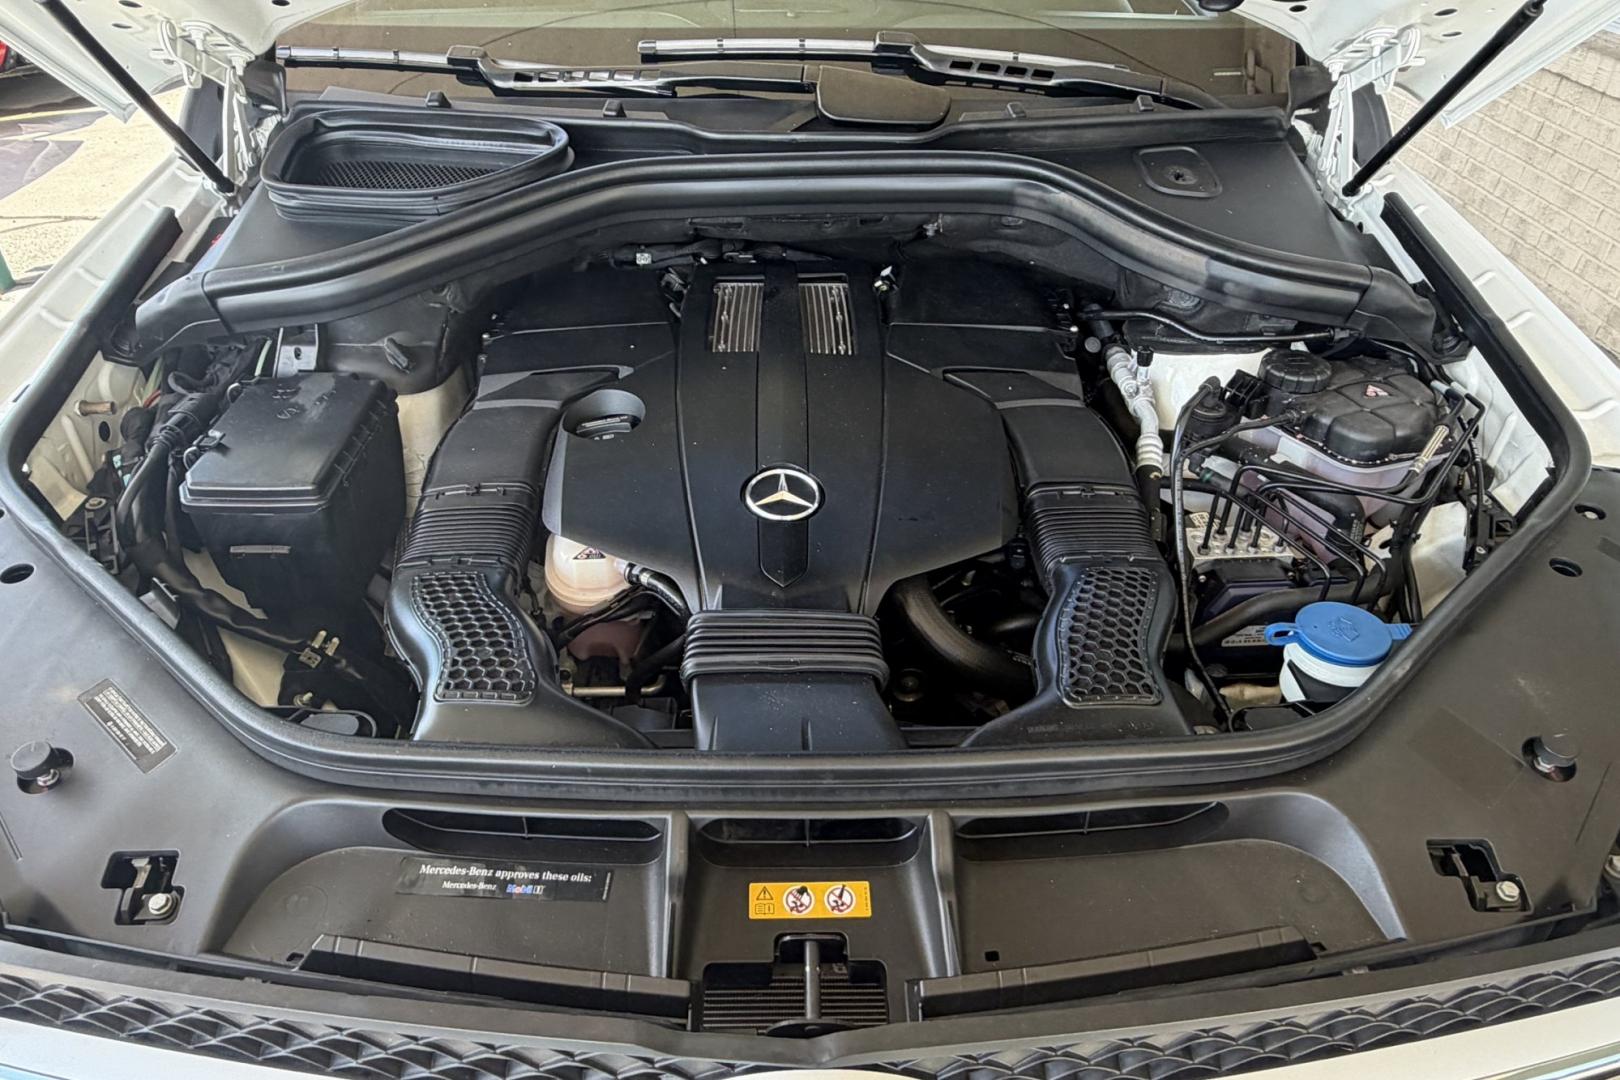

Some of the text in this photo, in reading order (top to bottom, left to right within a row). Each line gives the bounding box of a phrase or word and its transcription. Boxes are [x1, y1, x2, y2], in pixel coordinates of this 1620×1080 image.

[419, 864, 592, 882] Mercedes-Benz approves these oils:
[442, 880, 497, 890] Mercedes-Benz
